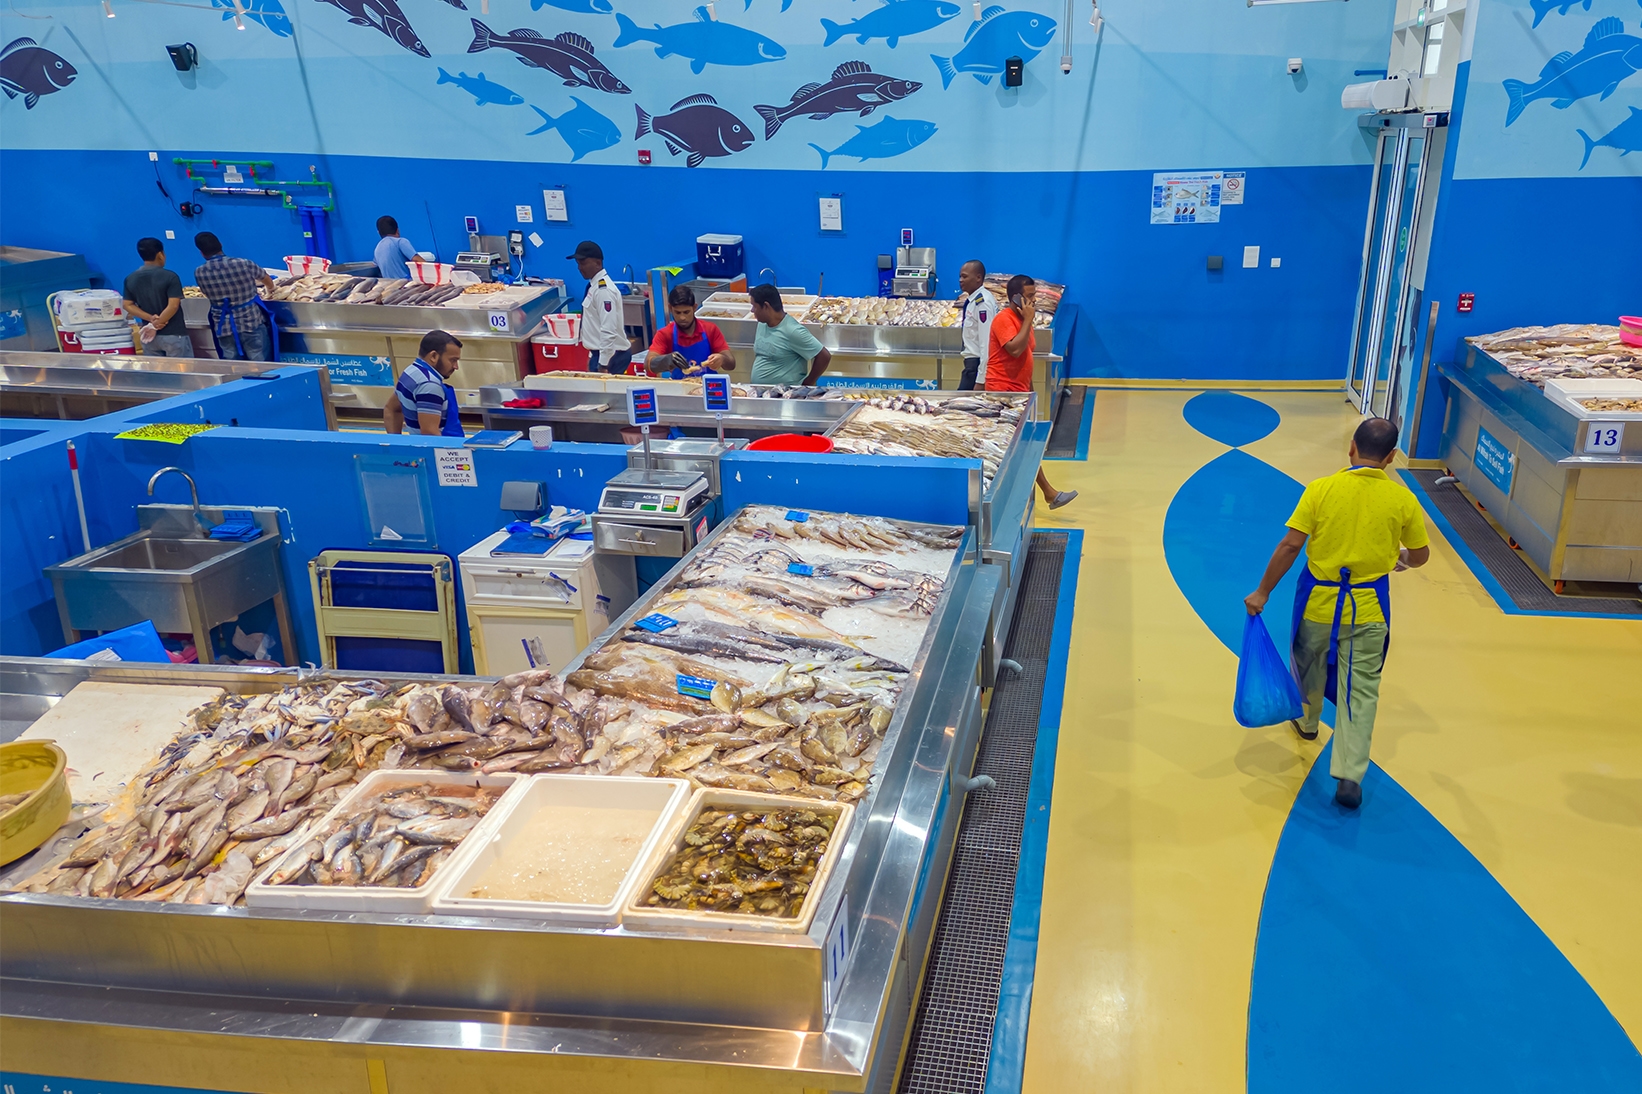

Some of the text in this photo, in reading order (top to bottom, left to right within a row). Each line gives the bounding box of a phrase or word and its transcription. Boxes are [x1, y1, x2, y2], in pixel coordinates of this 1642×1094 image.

[491, 315, 506, 327] 03
[336, 367, 354, 376] Fresh
[354, 368, 368, 377] Fish
[1593, 429, 1618, 446] 13
